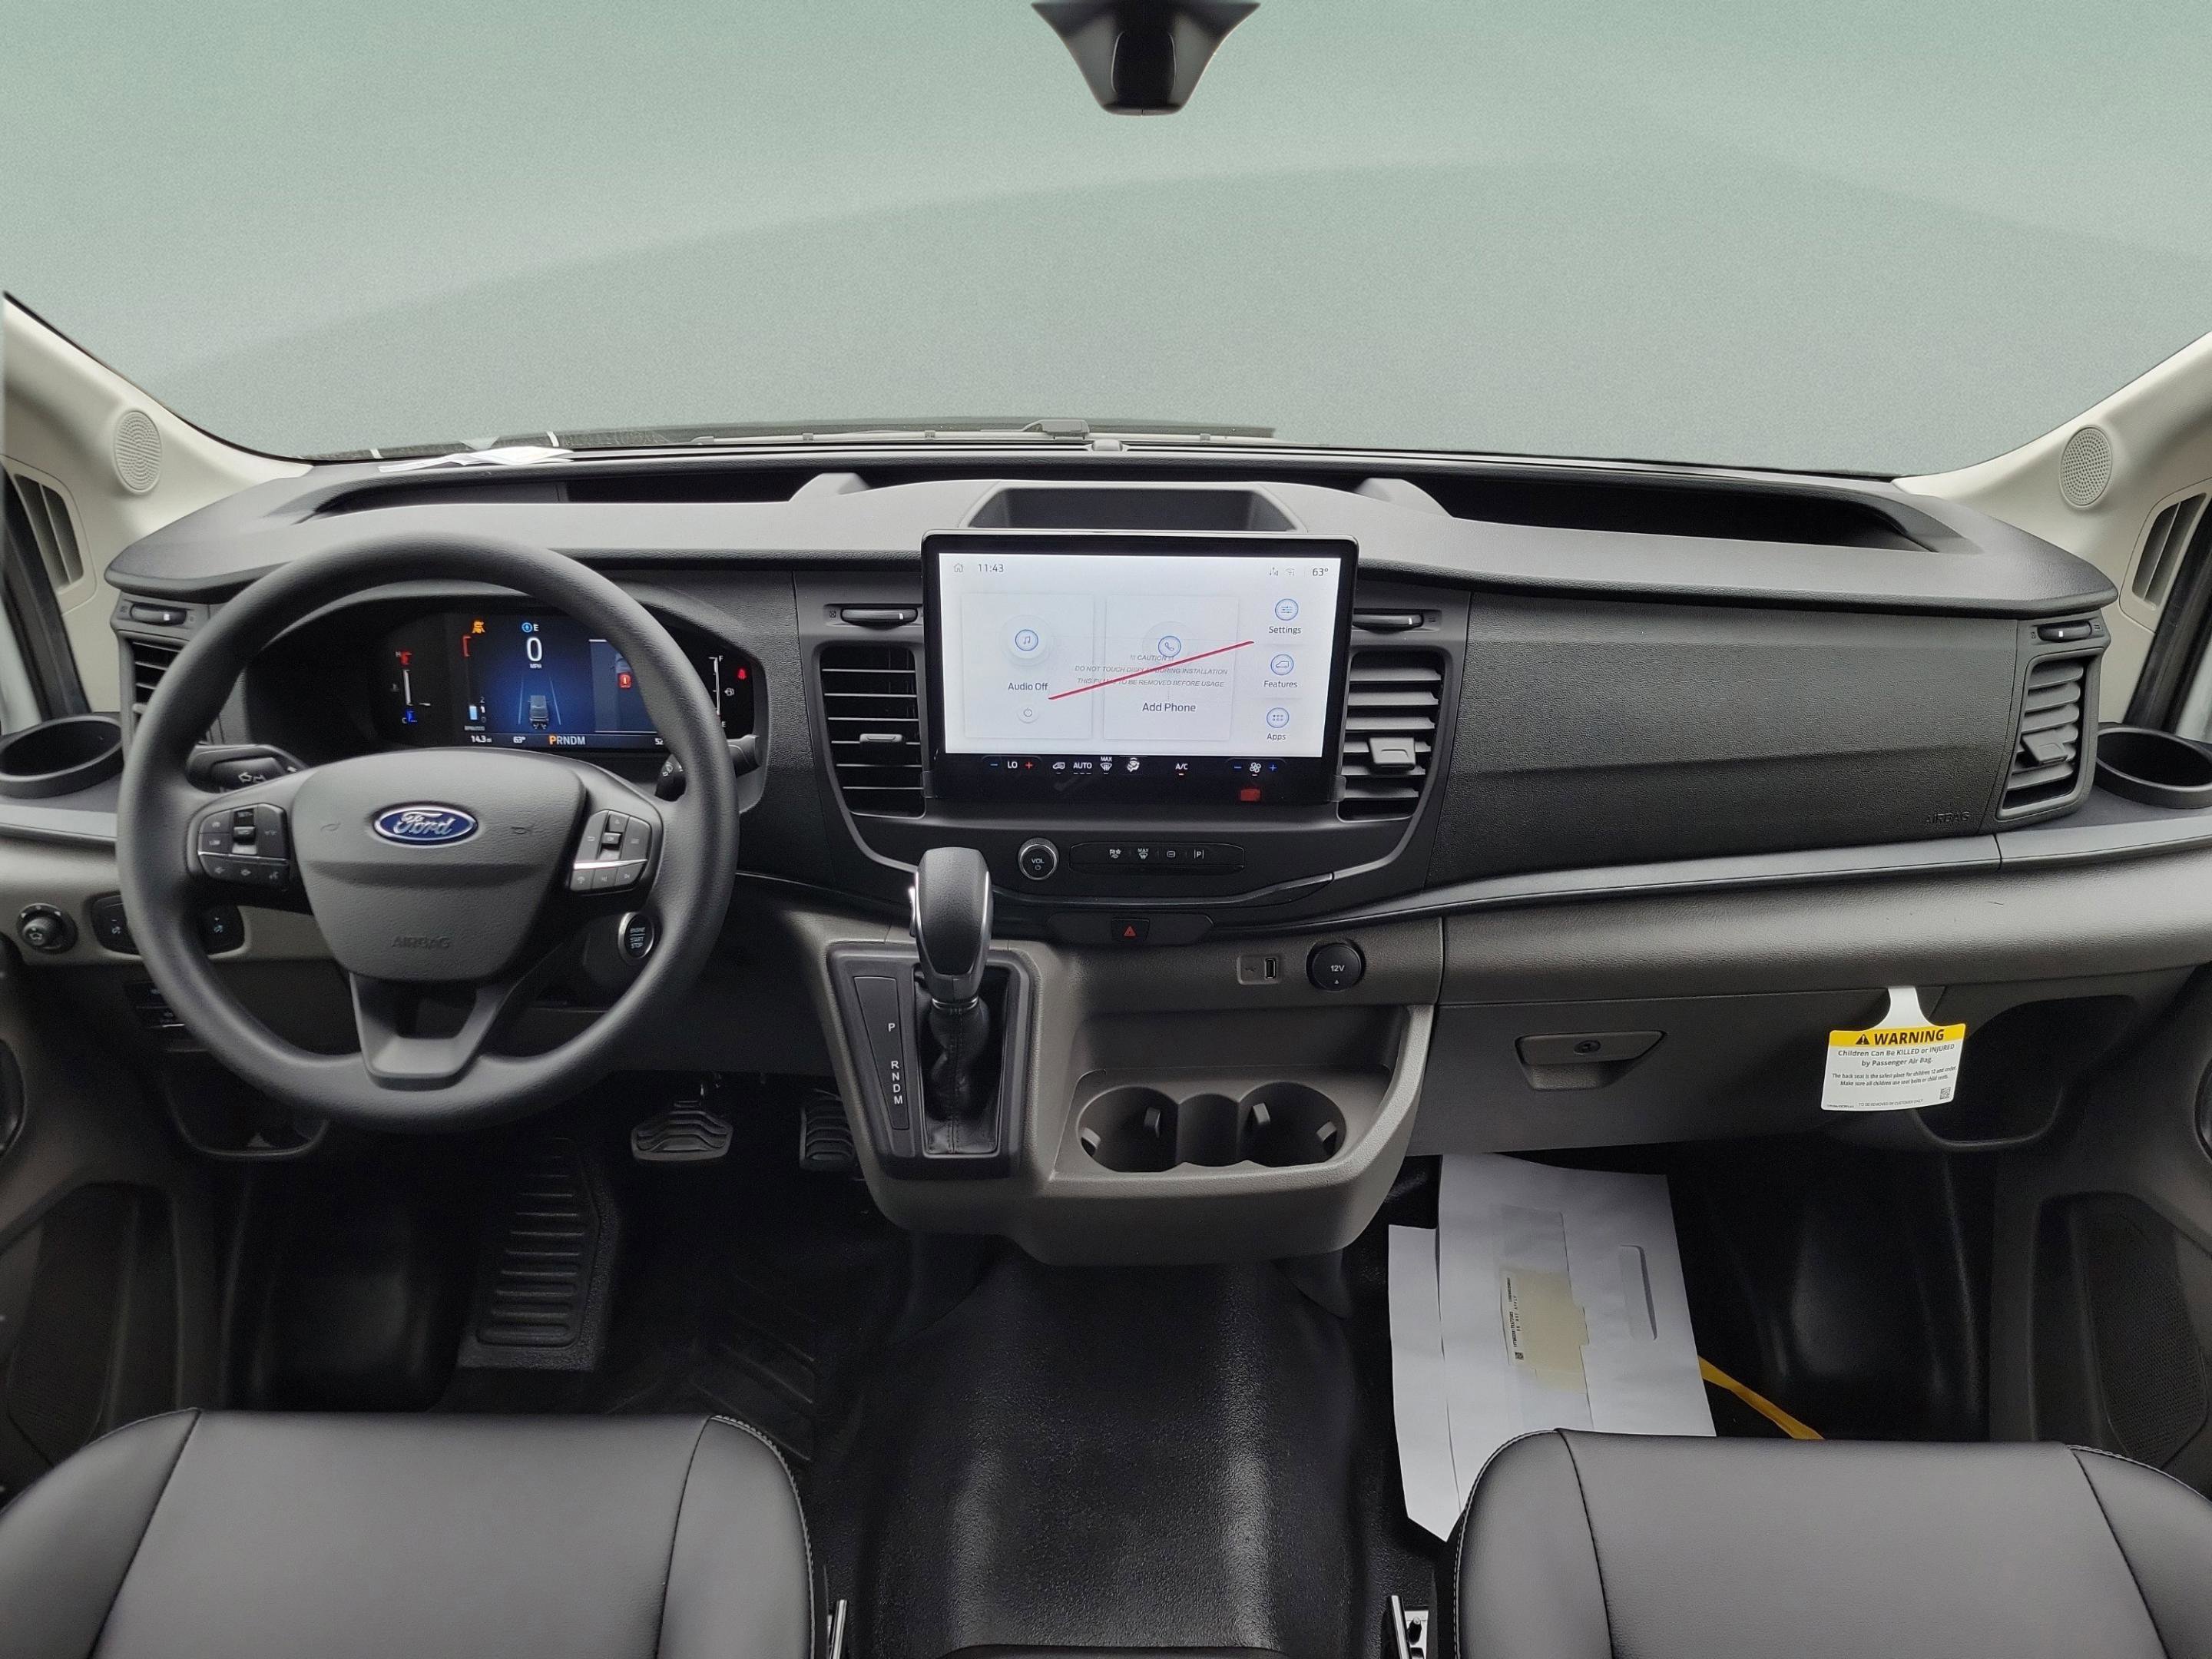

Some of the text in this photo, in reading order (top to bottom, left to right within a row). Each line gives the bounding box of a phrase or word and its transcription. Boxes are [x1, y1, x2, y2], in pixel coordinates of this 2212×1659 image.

[979, 564, 1004, 573] 11:43
[1313, 568, 1329, 577] 63°
[1269, 626, 1301, 634] Settings
[527, 637, 542, 661] 0
[1008, 682, 1048, 690] Audio Off
[1142, 703, 1196, 712] Add Phone
[1267, 733, 1286, 742] Apps
[1926, 811, 1970, 824] AIRBAG
[393, 811, 456, 835] Ford
[888, 1023, 896, 1032] P
[1874, 1029, 1945, 1045] WARNING
[1929, 1044, 1955, 1054] INJURED
[891, 1061, 899, 1069] R
[892, 1072, 900, 1081] N
[893, 1084, 901, 1093] D
[894, 1096, 903, 1105] M
